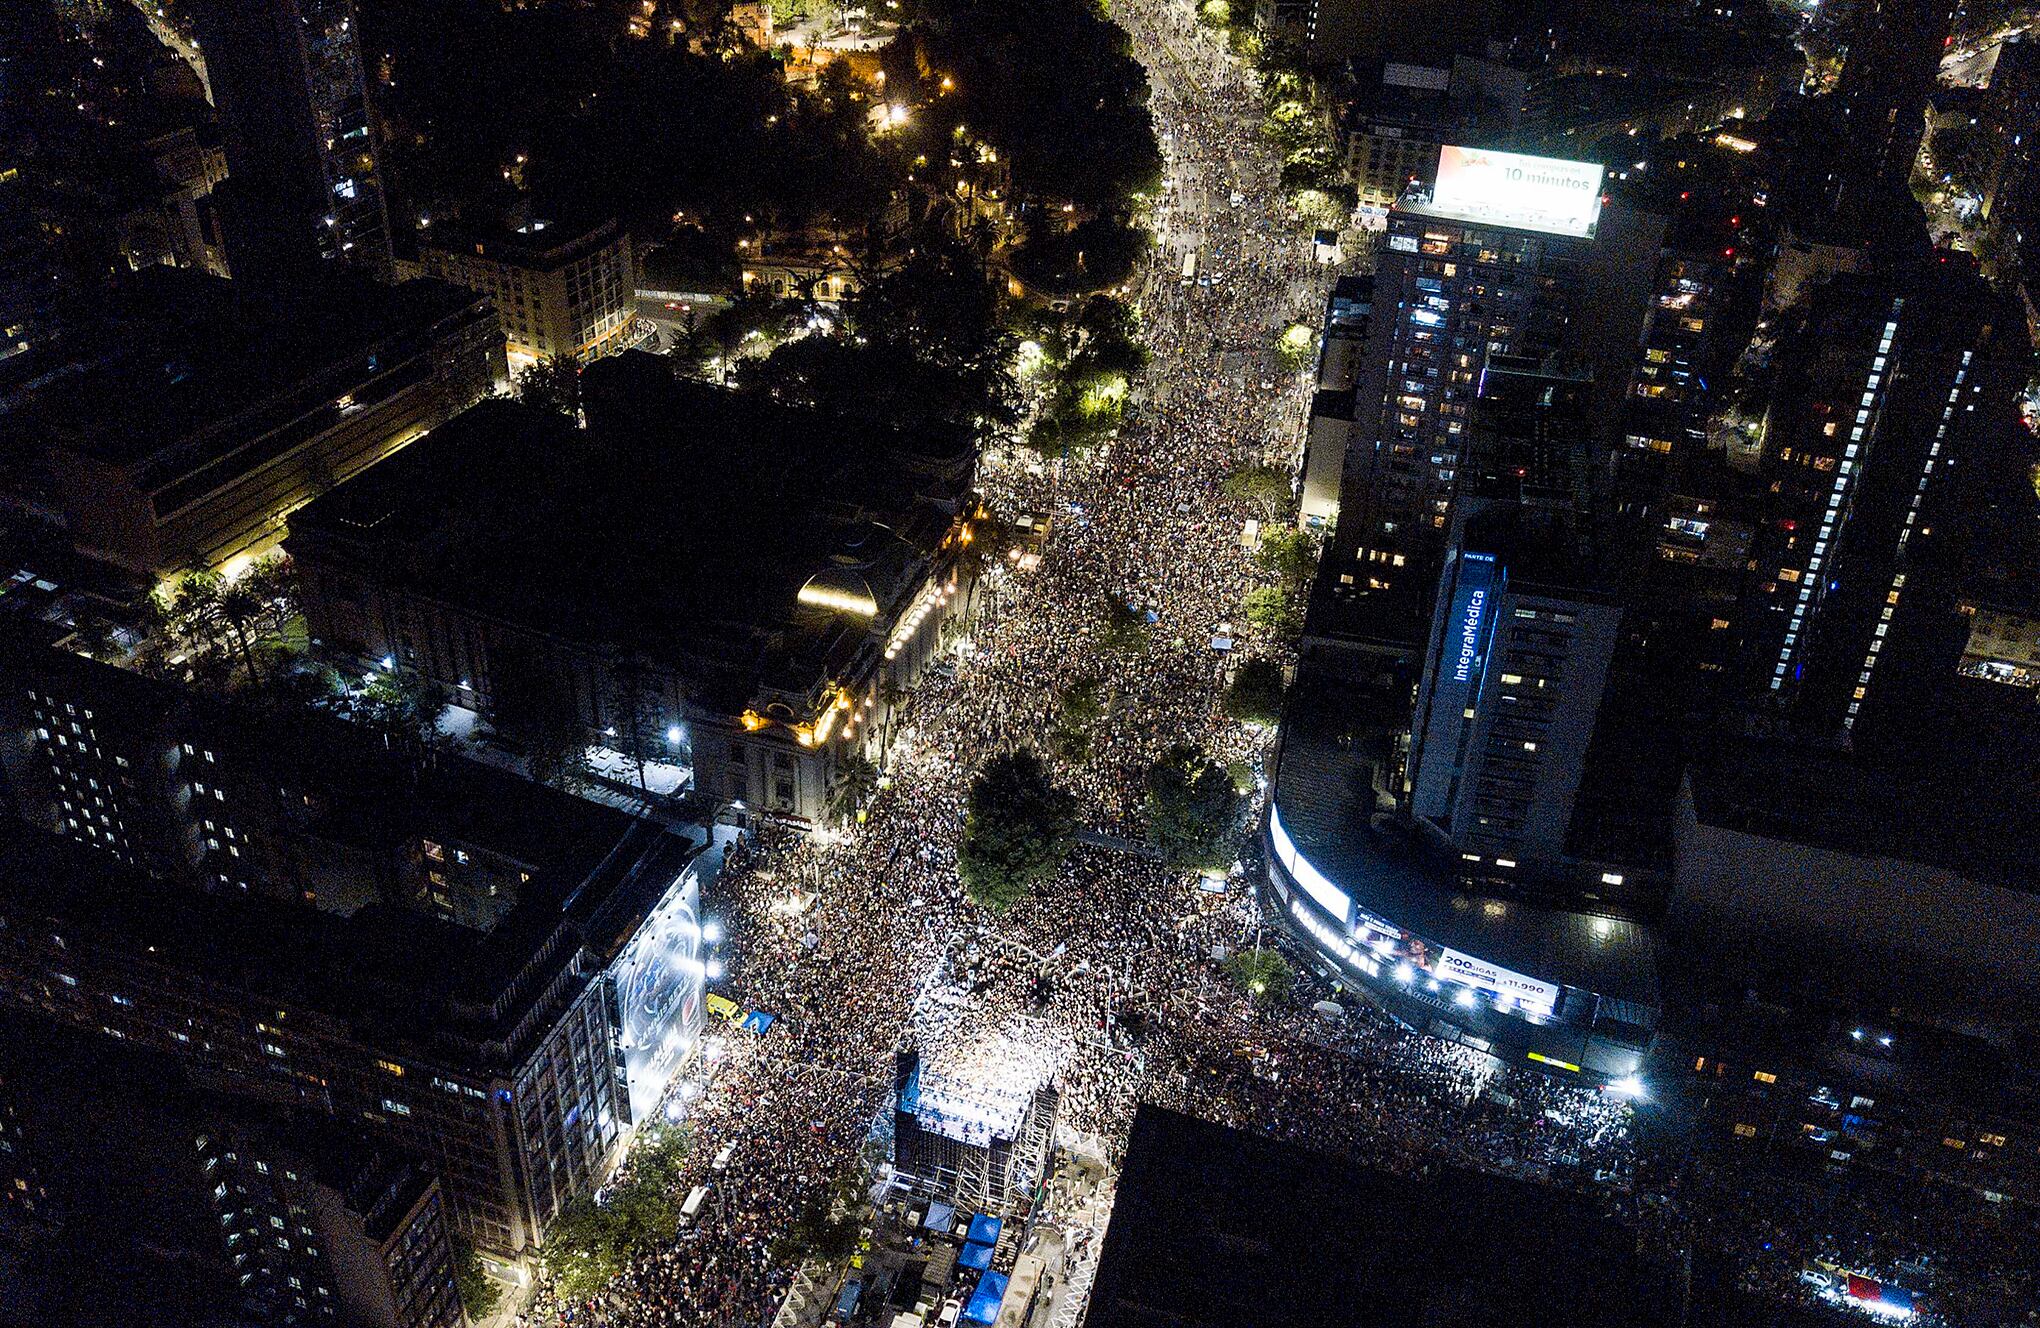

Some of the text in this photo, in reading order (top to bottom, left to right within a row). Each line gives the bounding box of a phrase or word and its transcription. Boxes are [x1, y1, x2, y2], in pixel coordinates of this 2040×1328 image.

[1504, 167, 1590, 190] 10 minutos
[1464, 553, 1484, 561] PARTE
[1454, 590, 1484, 681] IntegraMédica
[1446, 956, 1472, 969] 200
